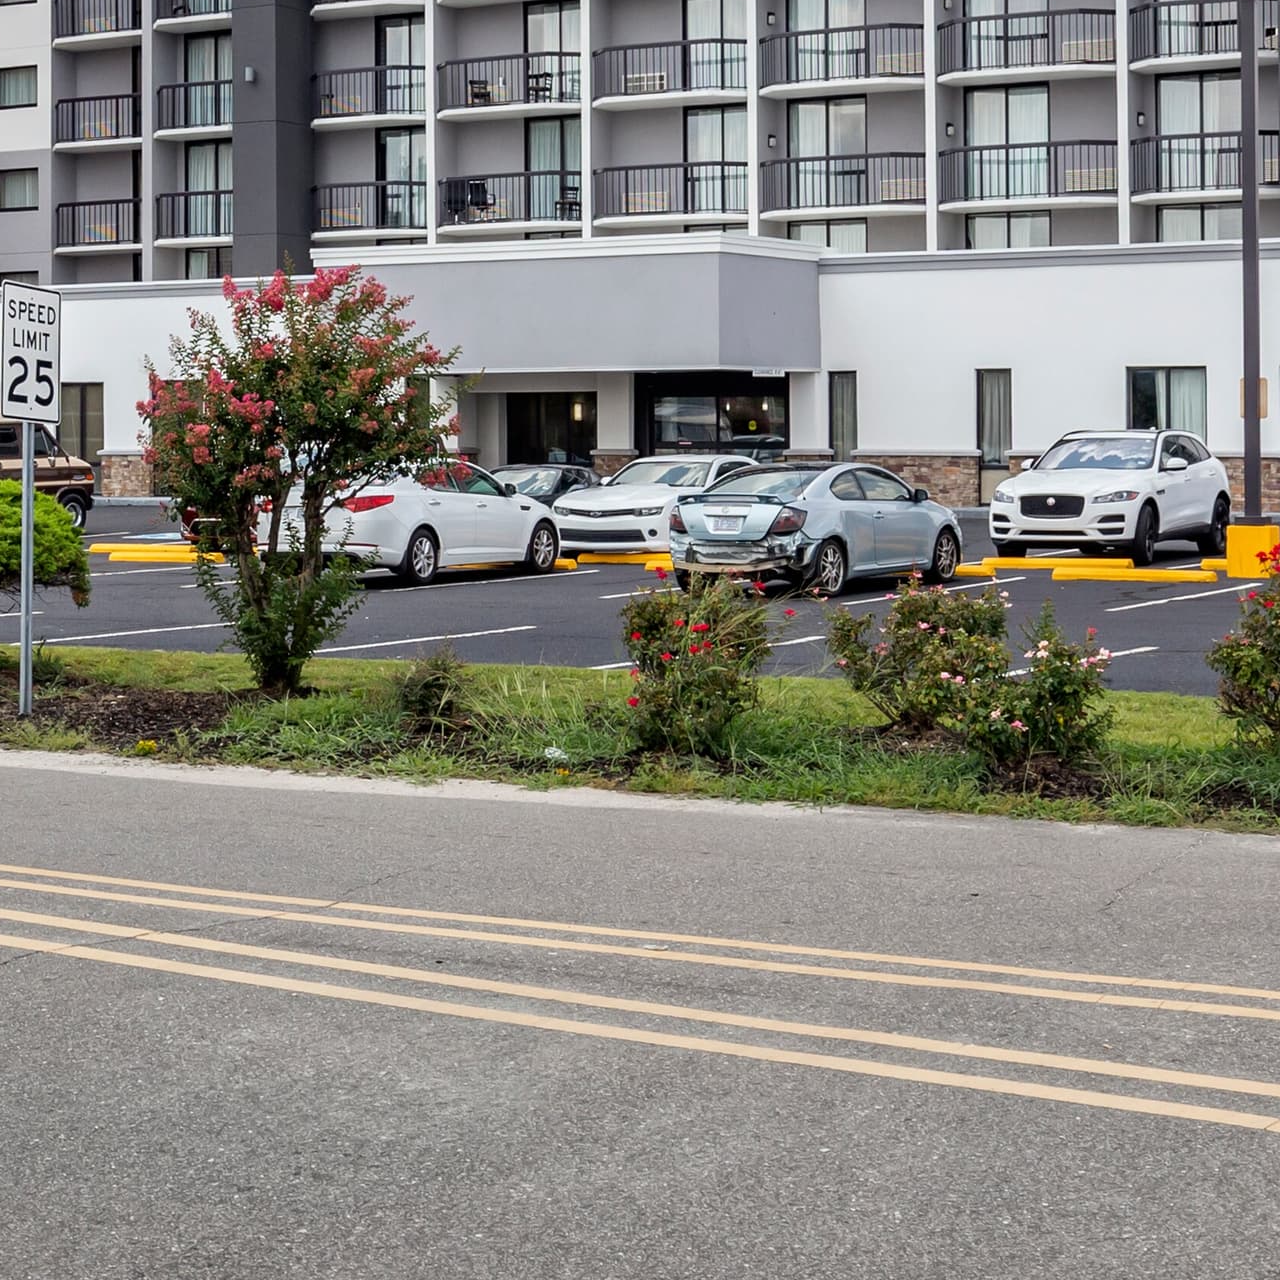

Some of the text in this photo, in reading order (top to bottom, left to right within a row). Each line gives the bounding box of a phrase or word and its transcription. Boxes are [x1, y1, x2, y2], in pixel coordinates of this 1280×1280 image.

[8, 299, 56, 325] SPEED
[13, 327, 50, 352] LIMIT
[7, 355, 54, 407] 25
